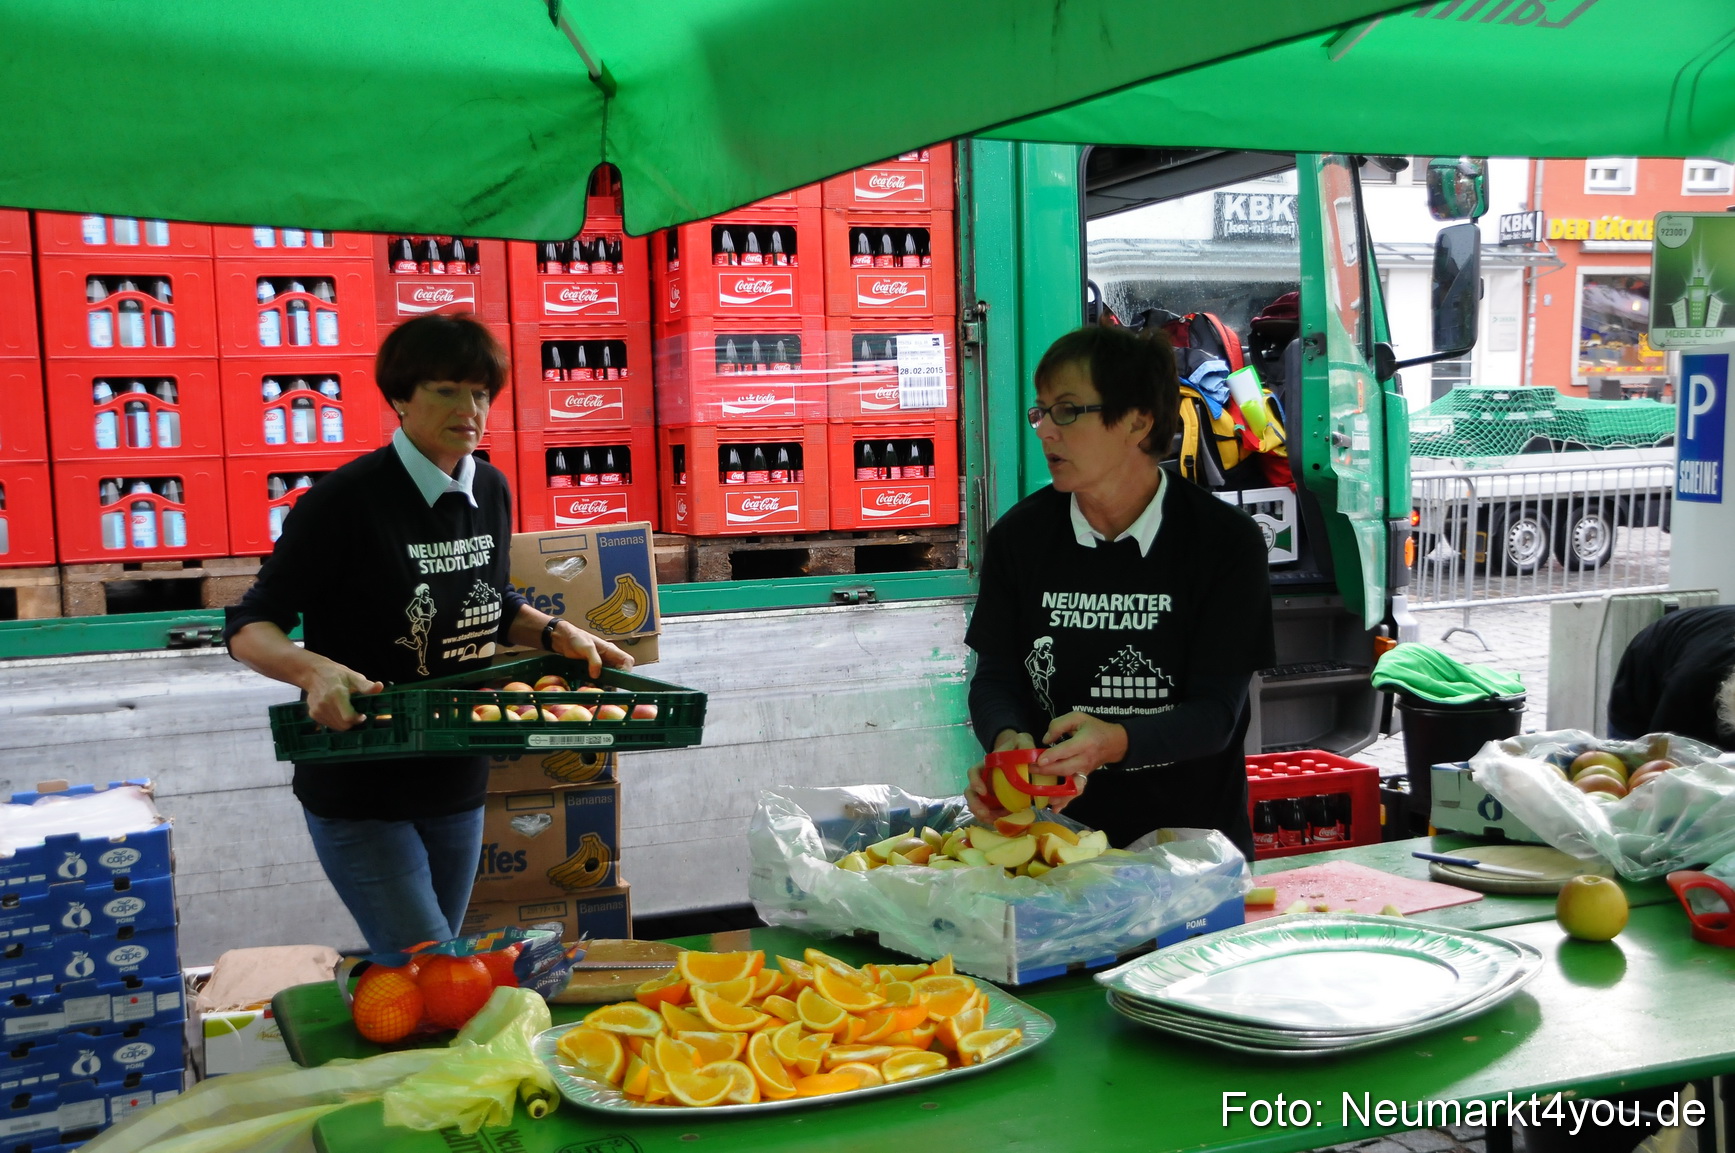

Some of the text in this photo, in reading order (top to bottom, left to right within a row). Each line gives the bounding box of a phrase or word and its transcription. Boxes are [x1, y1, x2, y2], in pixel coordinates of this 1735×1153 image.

[869, 175, 906, 188] Coca-Cola
[1224, 194, 1295, 221] KBK
[1500, 213, 1533, 233] KBK
[1549, 218, 1590, 240] DER
[1661, 228, 1687, 236] 923001
[734, 280, 775, 293] Coca-Cola
[872, 281, 908, 294] Coca-Cola
[413, 288, 455, 301] Coca-Cola
[560, 288, 599, 301] Coca-Cola
[1665, 328, 1726, 338] MOBILE CITY
[900, 367, 944, 375] 28.02.2015
[565, 394, 604, 407] Coca-Cola
[1686, 374, 1716, 440] P
[1679, 460, 1718, 495] SCHEINE
[742, 497, 780, 511] Coca-Cola
[876, 492, 912, 506] Coca-Cola
[570, 500, 609, 514] Coca-Cola
[408, 534, 495, 560] NEUMARKTER
[600, 534, 645, 548] Bananas
[419, 550, 491, 575] STADTLAUF
[1041, 591, 1173, 612] NEUMARKTER
[1049, 610, 1159, 630] STADTLAUF
[567, 792, 613, 807] Bananas
[107, 853, 134, 865] cape
[111, 902, 138, 914] cape
[579, 900, 624, 914] Bananas
[1186, 917, 1207, 930] POME
[114, 951, 141, 963] cape
[120, 1048, 148, 1060] cape
